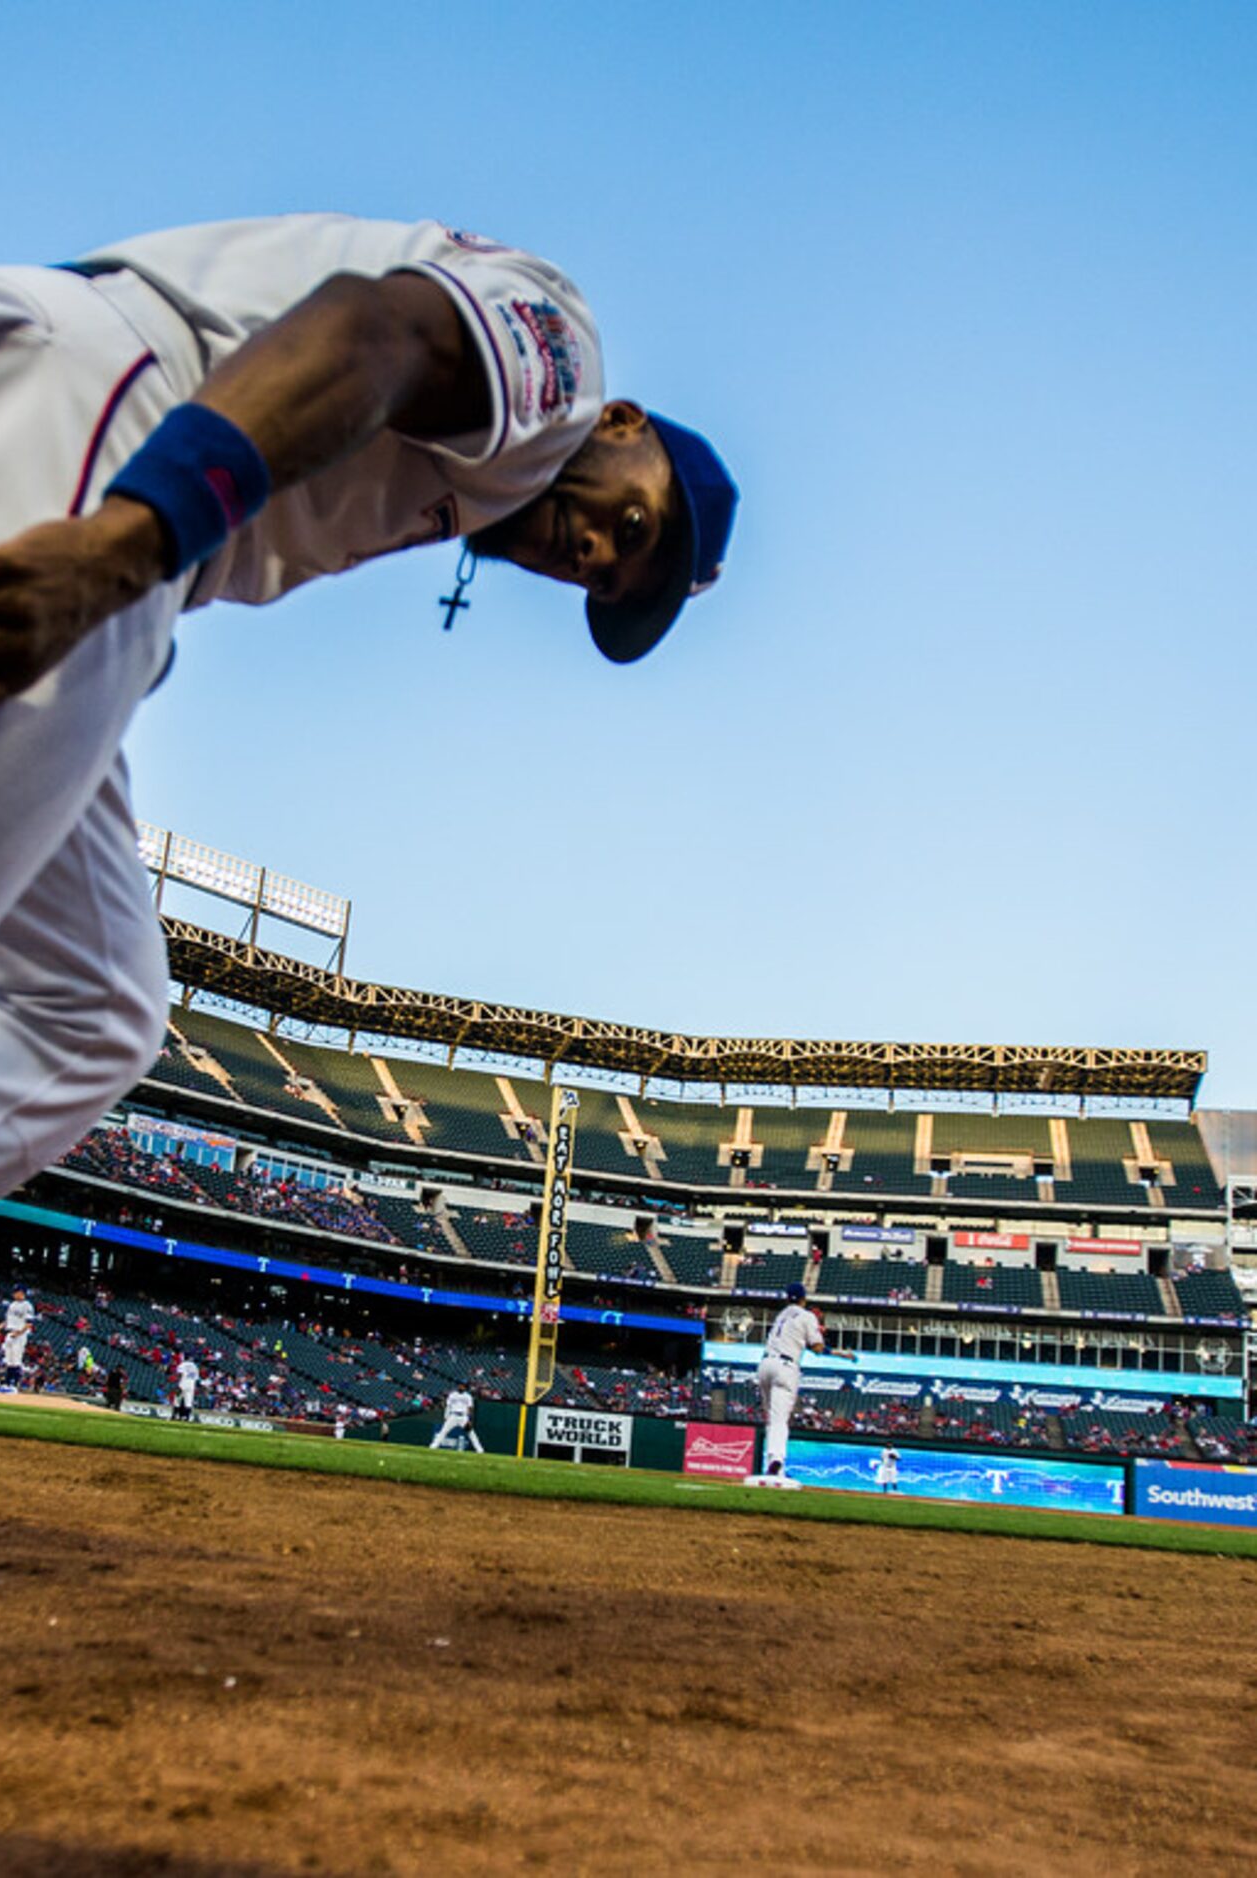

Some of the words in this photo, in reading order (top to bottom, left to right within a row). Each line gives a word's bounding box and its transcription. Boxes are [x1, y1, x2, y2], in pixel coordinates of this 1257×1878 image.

[556, 1125, 569, 1171] EAT
[551, 1178, 567, 1228] MOR
[547, 1414, 623, 1434] TRUCK
[546, 1428, 622, 1447] WORLD
[986, 1469, 1009, 1494] T
[1147, 1484, 1256, 1512] Southwest
